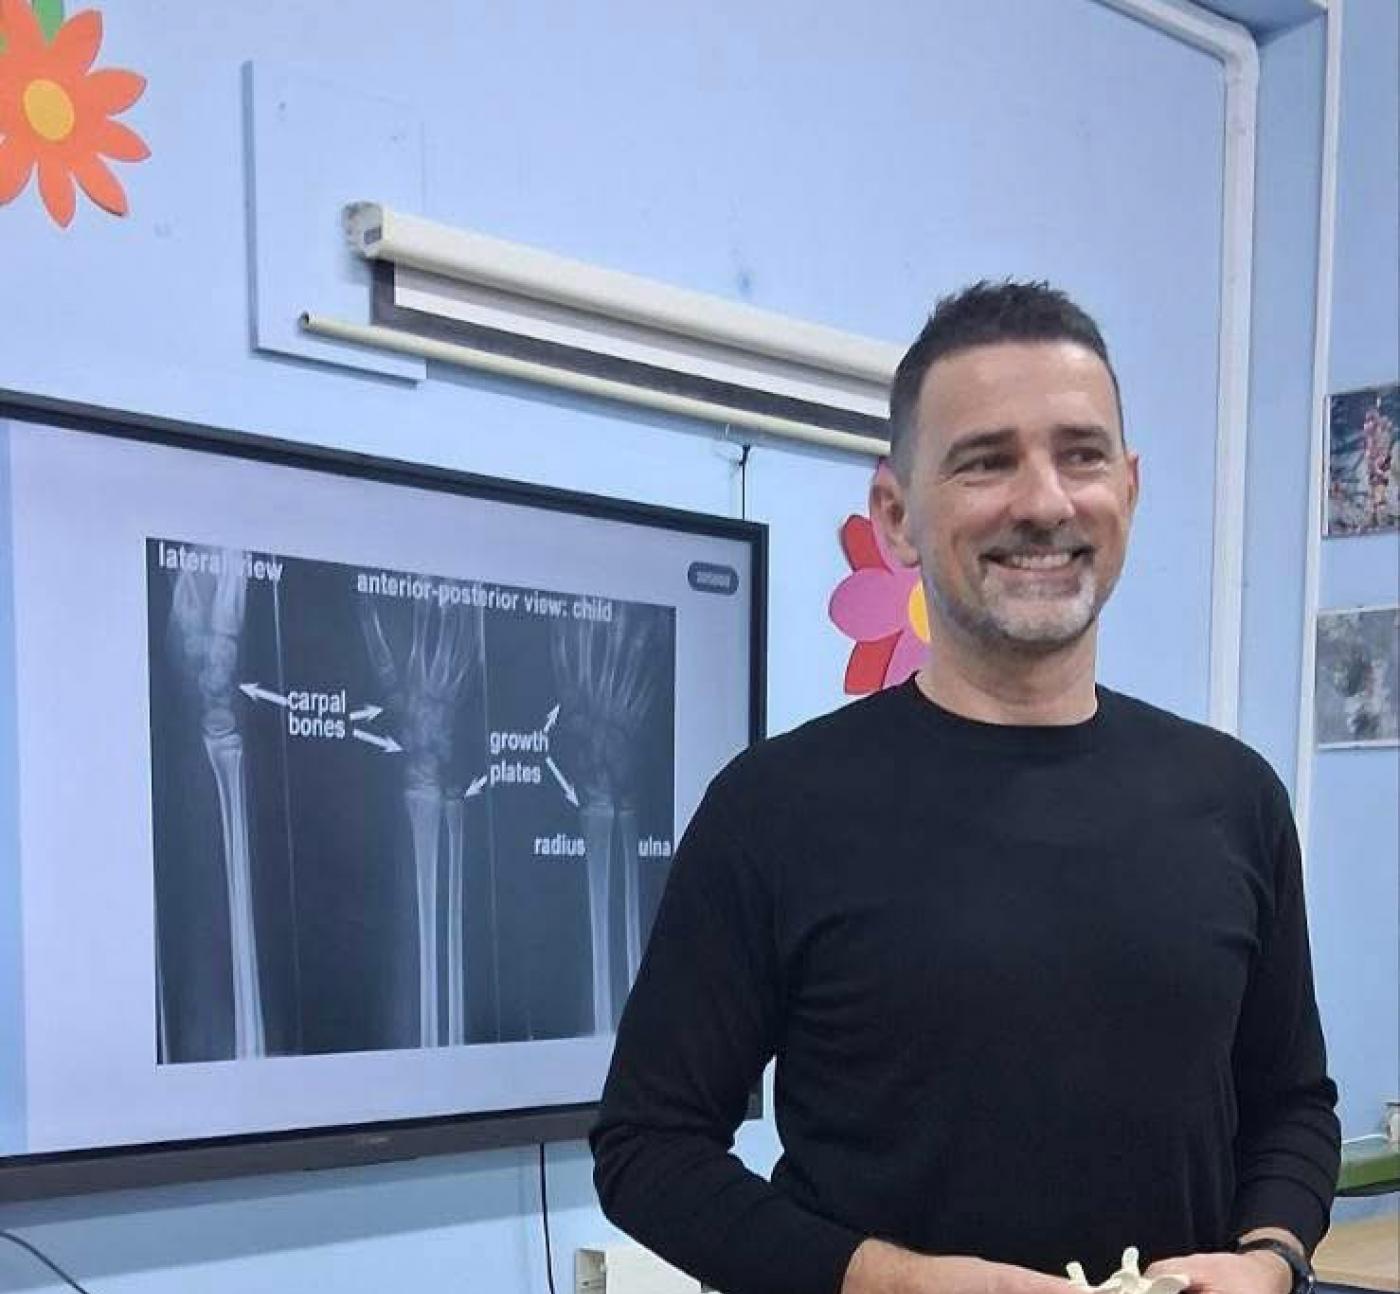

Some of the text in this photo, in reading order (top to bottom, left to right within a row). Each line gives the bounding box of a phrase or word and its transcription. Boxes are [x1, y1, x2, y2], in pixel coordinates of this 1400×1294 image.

[357, 573, 613, 622] anterior-posterior view: child
[287, 689, 346, 718] carpal
[289, 711, 346, 739] bones
[490, 730, 549, 755] growth
[490, 760, 541, 785] plates
[534, 833, 586, 857] radius
[638, 836, 672, 857] ulna
